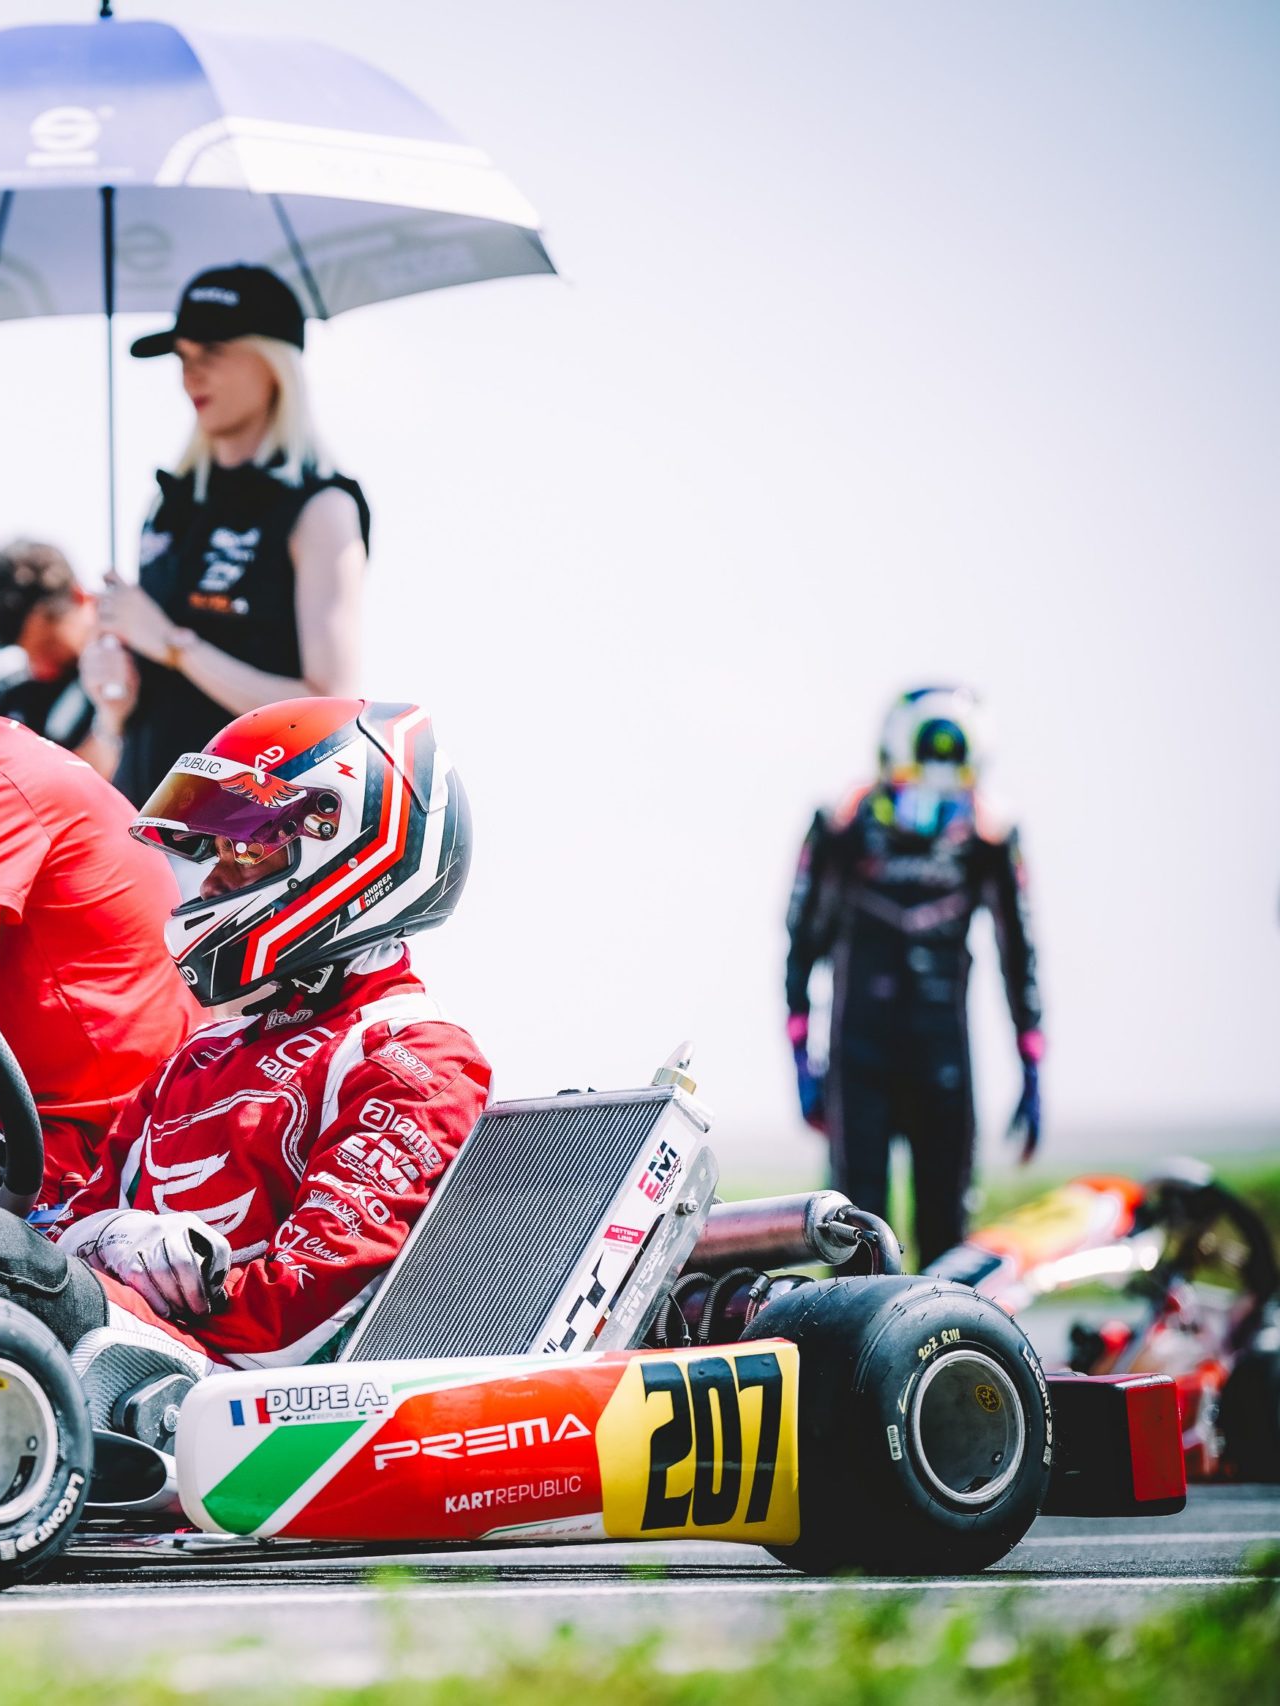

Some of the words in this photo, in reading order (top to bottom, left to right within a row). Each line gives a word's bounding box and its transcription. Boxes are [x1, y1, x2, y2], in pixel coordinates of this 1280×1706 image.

[176, 755, 222, 775] PUBLIC
[363, 873, 392, 900] ANDREA
[365, 887, 385, 908] DUPE
[307, 1171, 391, 1225] JECKO
[303, 1237, 348, 1265] Chains
[266, 1385, 349, 1413] DUPE
[355, 1382, 389, 1407] A.
[373, 1413, 592, 1470] PREMA
[640, 1352, 783, 1531] 207
[445, 1475, 582, 1514] KARTREPUBLIC
